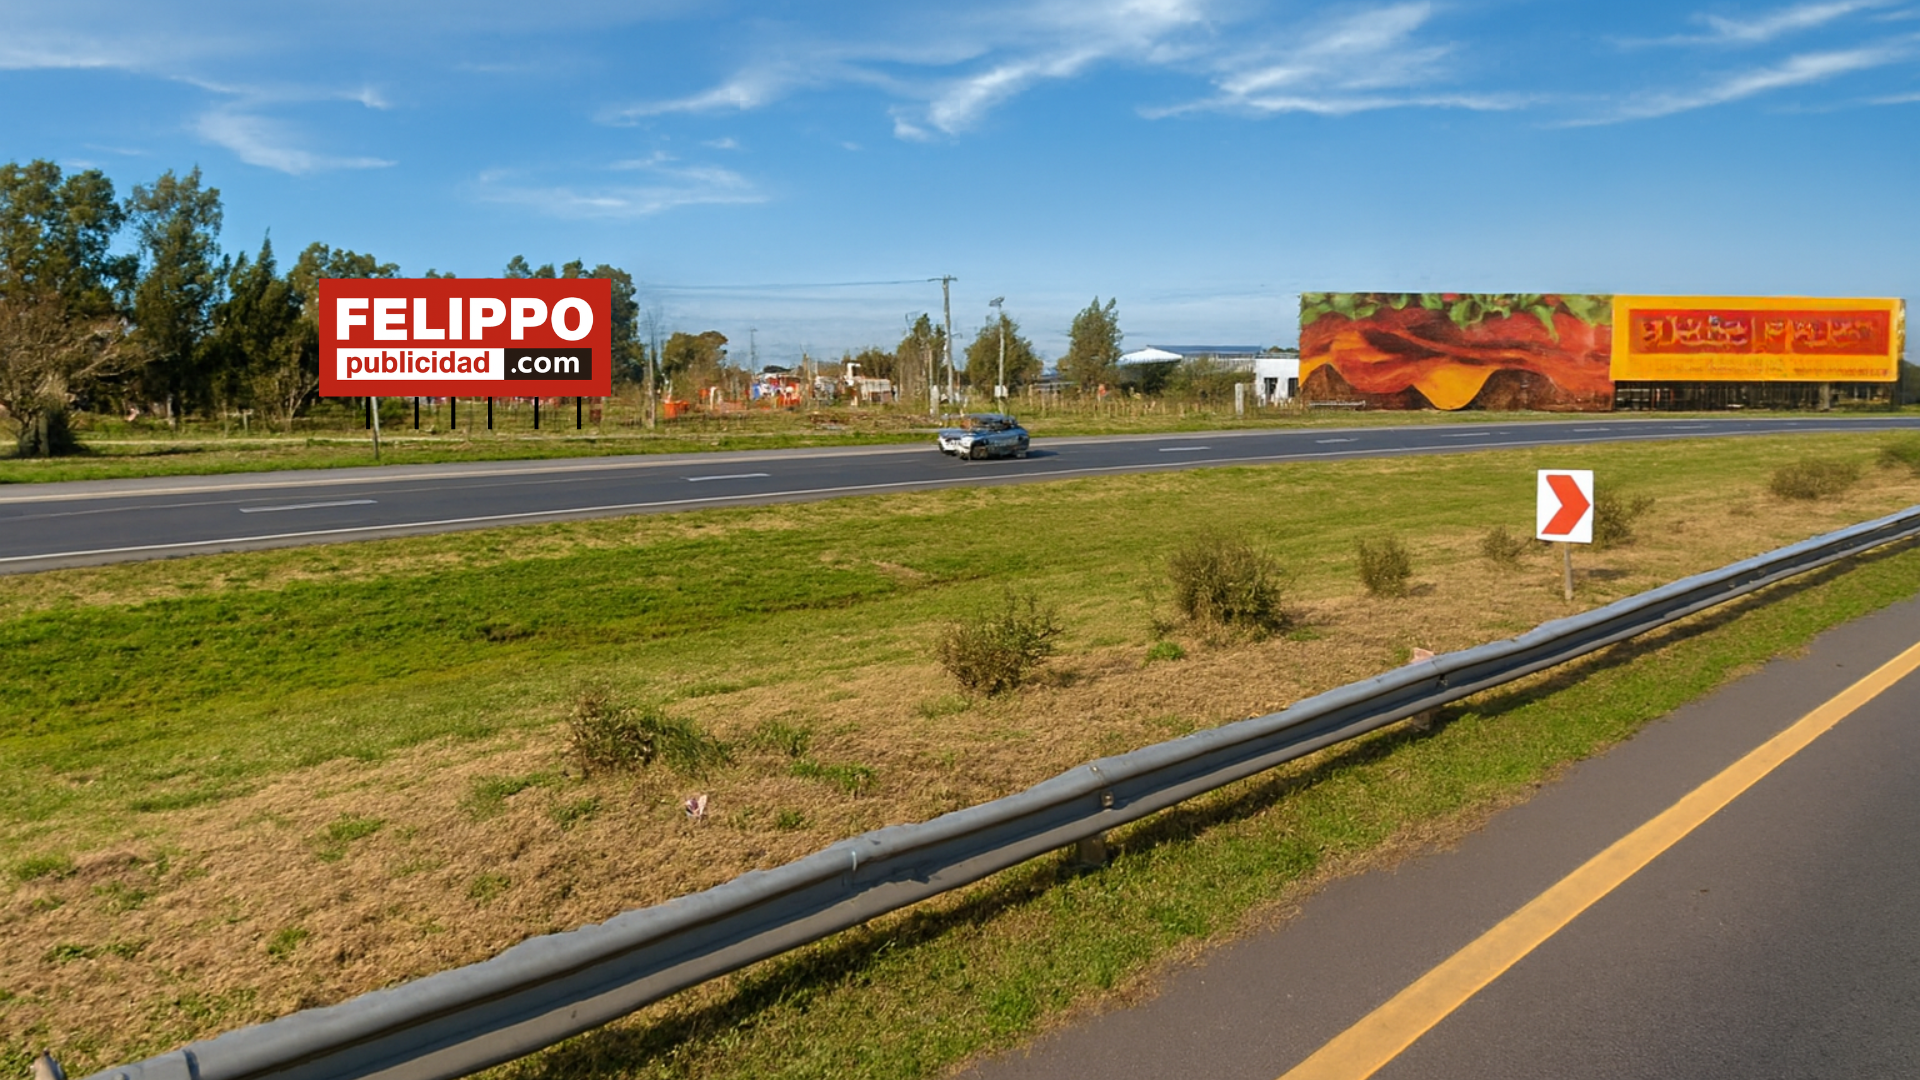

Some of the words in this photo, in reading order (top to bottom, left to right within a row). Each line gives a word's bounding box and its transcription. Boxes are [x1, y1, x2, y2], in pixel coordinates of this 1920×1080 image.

[337, 297, 593, 341] FELIPPO
[346, 351, 490, 379] publicidad
[511, 355, 580, 374] .com
